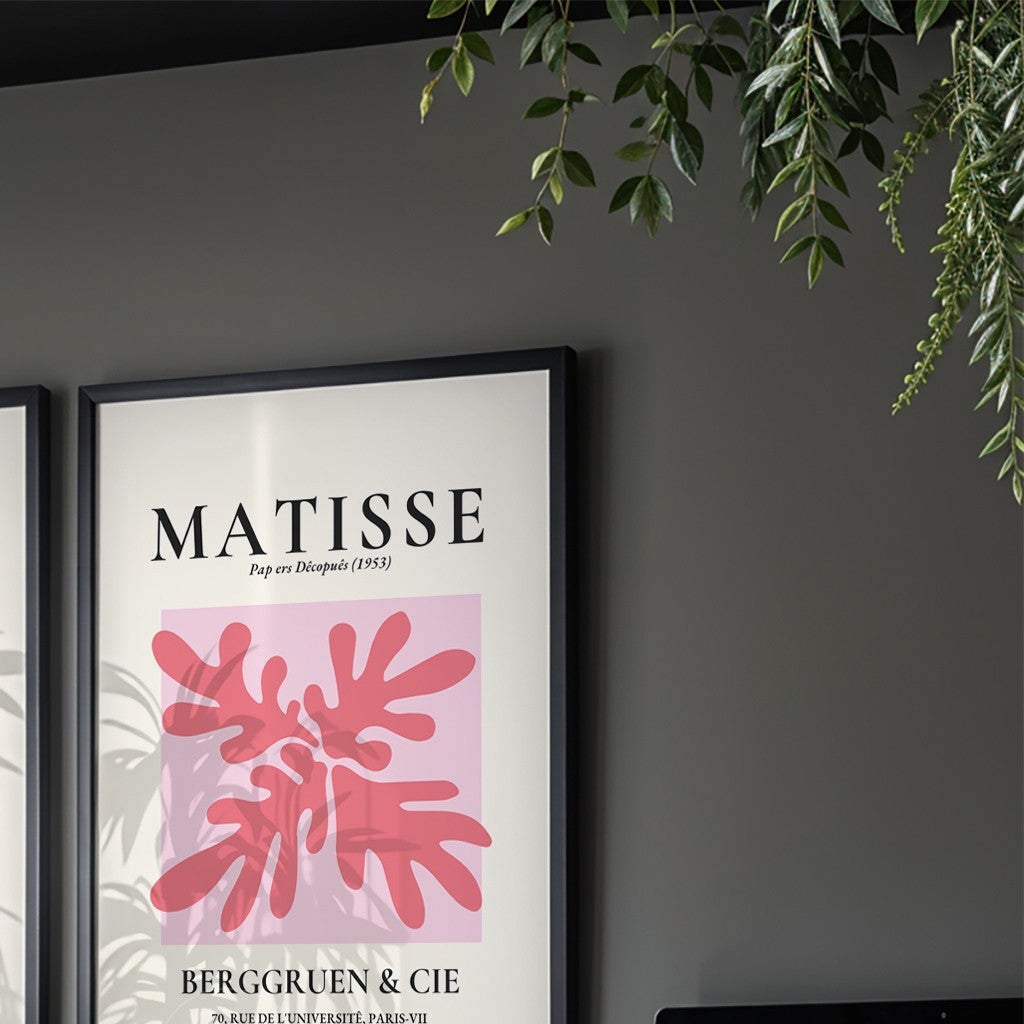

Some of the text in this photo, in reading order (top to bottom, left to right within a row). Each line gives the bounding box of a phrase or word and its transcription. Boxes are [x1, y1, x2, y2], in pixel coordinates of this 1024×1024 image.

[150, 487, 485, 562] MATISSE
[351, 555, 392, 573] (1953)
[181, 968, 460, 995] BERGGRUEN & CIE
[230, 1012, 256, 1024] RUE
[258, 1012, 275, 1024] DE
[368, 1012, 427, 1024] PARIS-VII
